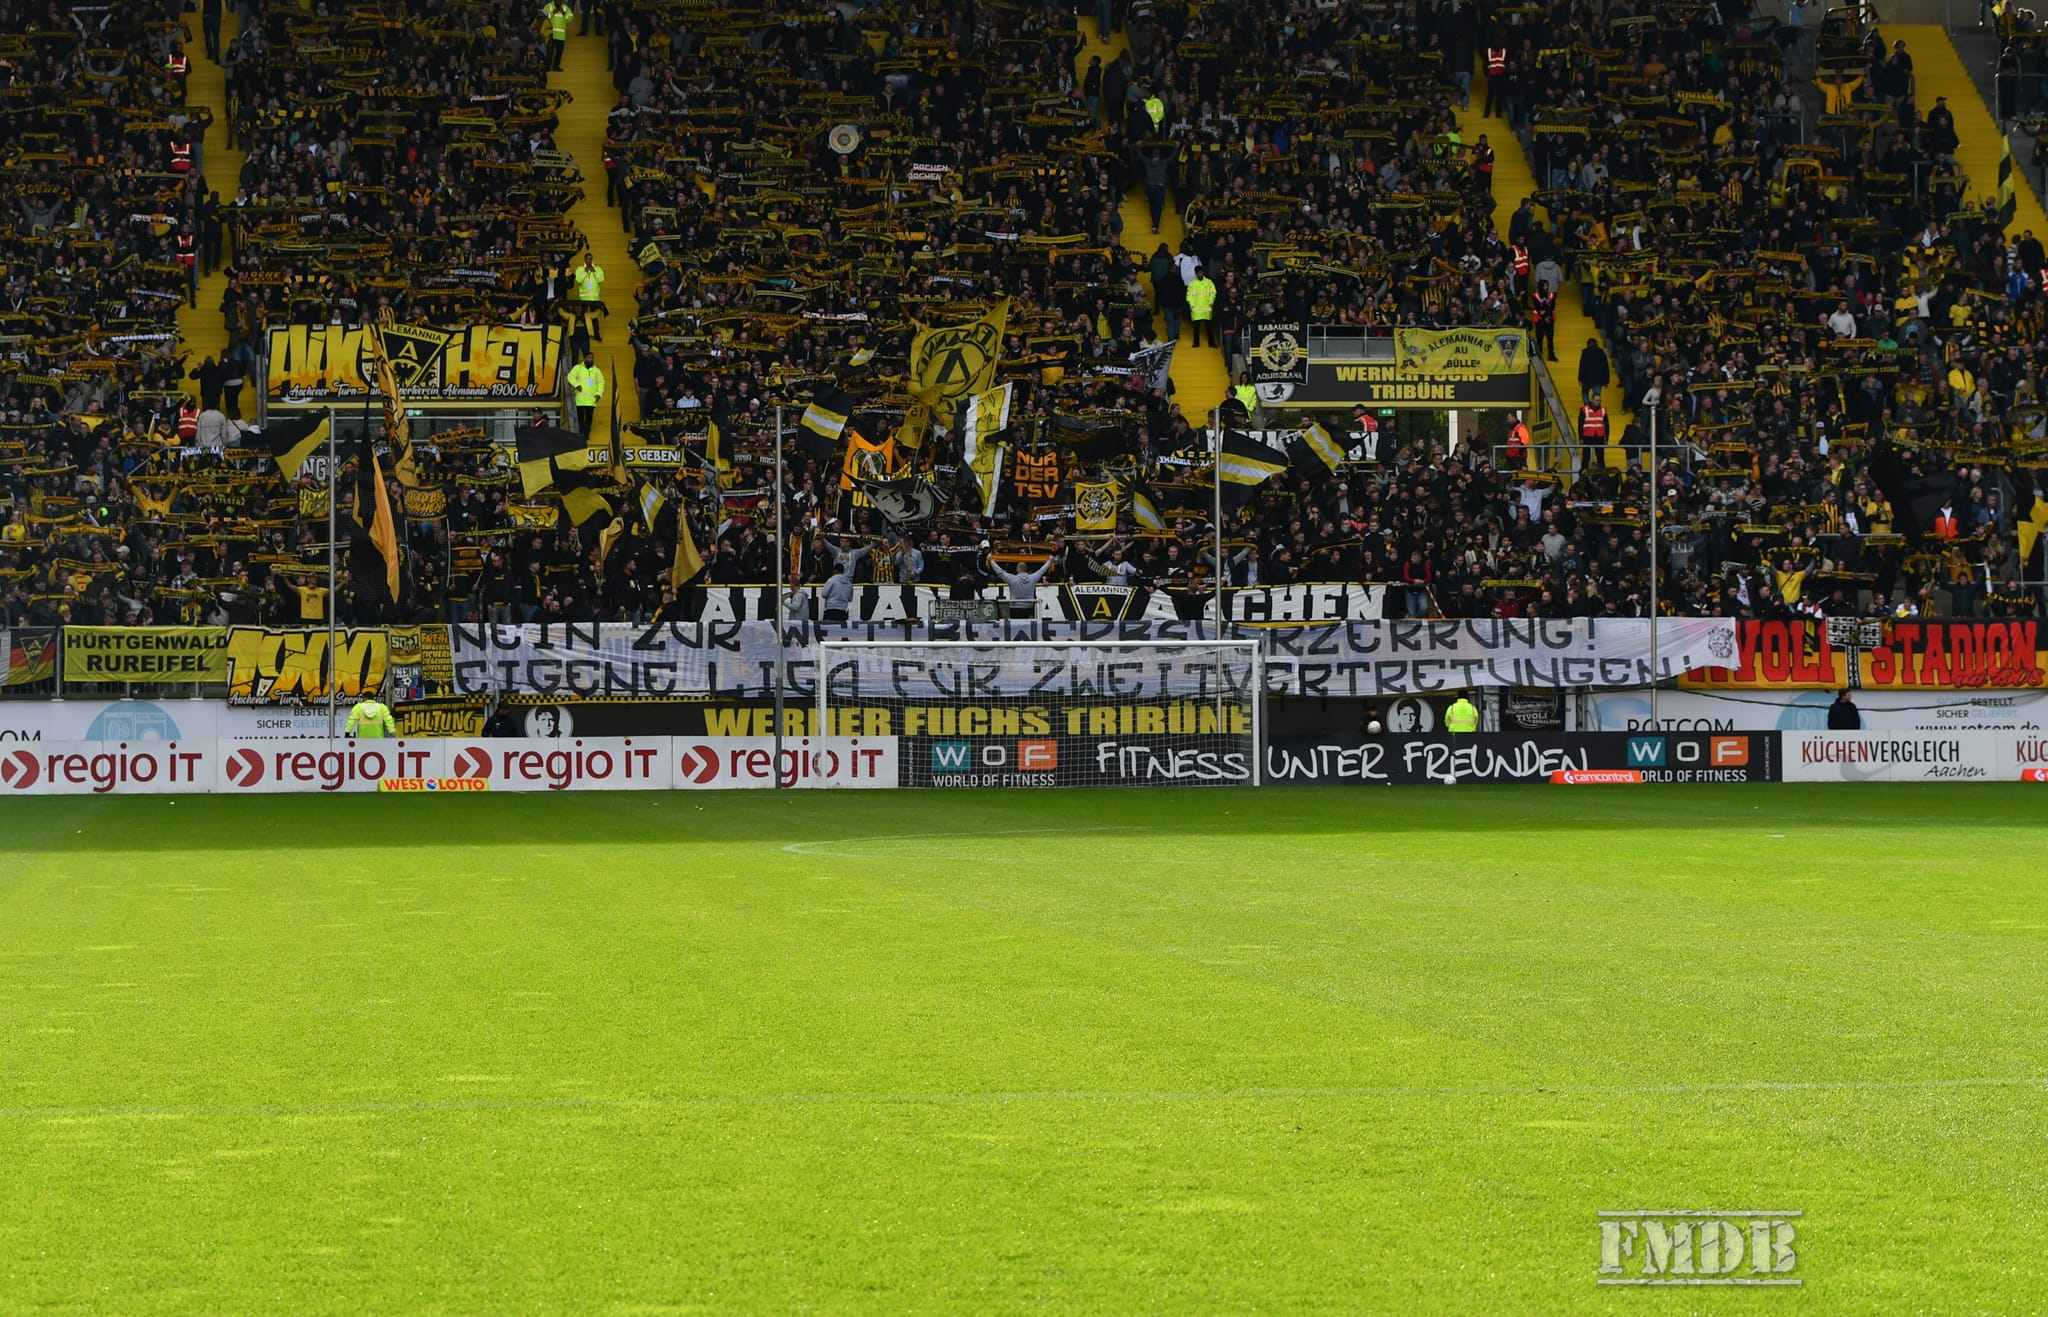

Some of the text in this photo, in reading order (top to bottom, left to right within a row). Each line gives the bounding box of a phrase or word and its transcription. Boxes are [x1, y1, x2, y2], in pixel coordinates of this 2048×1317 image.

[382, 323, 442, 341] ALEMANNIA
[1454, 346, 1468, 355] AU
[491, 383, 518, 396] 1900
[1369, 382, 1456, 400] TRIBÜNE
[639, 449, 681, 462] GEBEN!
[1016, 449, 1057, 466] NUR
[1015, 466, 1060, 482] DER
[1014, 482, 1059, 499] TSV
[1074, 585, 1130, 595] ALEMANNIA
[1091, 596, 1113, 618] A
[67, 632, 228, 650] HÜRTGENWALD
[453, 622, 598, 653] NEIN
[633, 622, 741, 653] ZUR
[1871, 620, 2038, 684] STADION
[86, 655, 212, 672] RUREIFEL
[454, 659, 678, 697] EIGENE
[708, 659, 859, 697] LIGA
[293, 708, 341, 717] BESTELT.
[703, 700, 1252, 736] WERNER FUCHS TRIBÜNE
[1936, 709, 1969, 719] SICHER
[256, 719, 291, 729] SICHER
[403, 709, 476, 735] HALTUNG
[1801, 736, 1961, 763] KÜCHENVERGLEICH
[48, 742, 203, 793] regio iT
[276, 740, 431, 791] regio iT
[503, 739, 658, 790] regio iT
[730, 738, 840, 788] regio
[851, 738, 885, 778] iT
[1095, 740, 1588, 780] FITNESS UNTER FREUNDEN
[1574, 771, 1634, 783] camcontrol
[1640, 770, 1748, 783] ORLD OF FITNESS
[1923, 763, 1988, 779] Aachen
[384, 778, 485, 790] WEST LOTTO
[933, 774, 1056, 787] WORLD OF FITNESS
